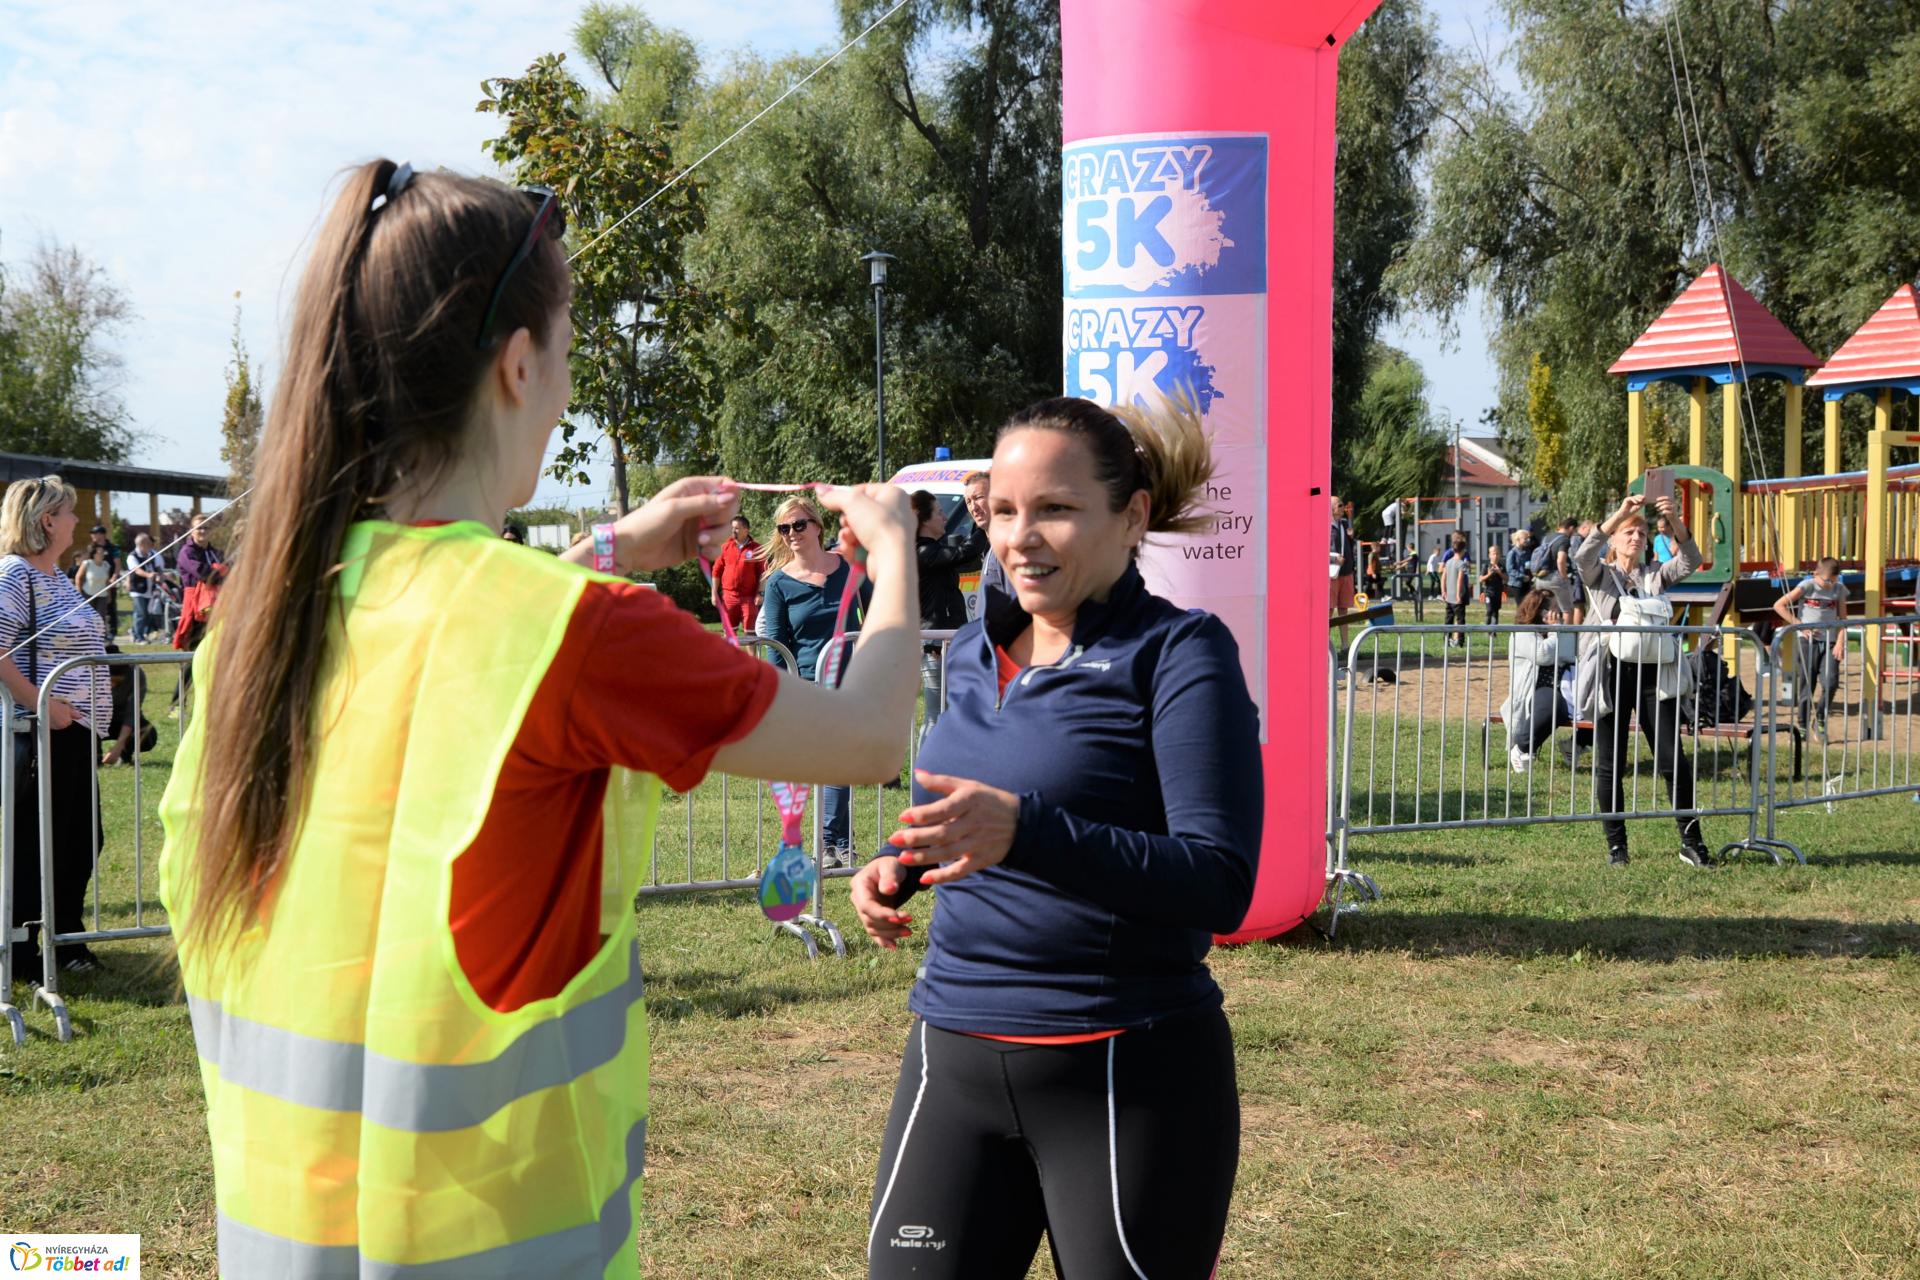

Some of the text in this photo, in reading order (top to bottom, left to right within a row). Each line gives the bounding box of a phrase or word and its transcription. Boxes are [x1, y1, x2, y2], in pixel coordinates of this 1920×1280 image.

[1065, 146, 1212, 199] CRAZY
[1076, 194, 1176, 272] 5K
[1069, 306, 1204, 351] CRAZY
[1079, 349, 1173, 411] 5K
[1182, 543, 1244, 559] water
